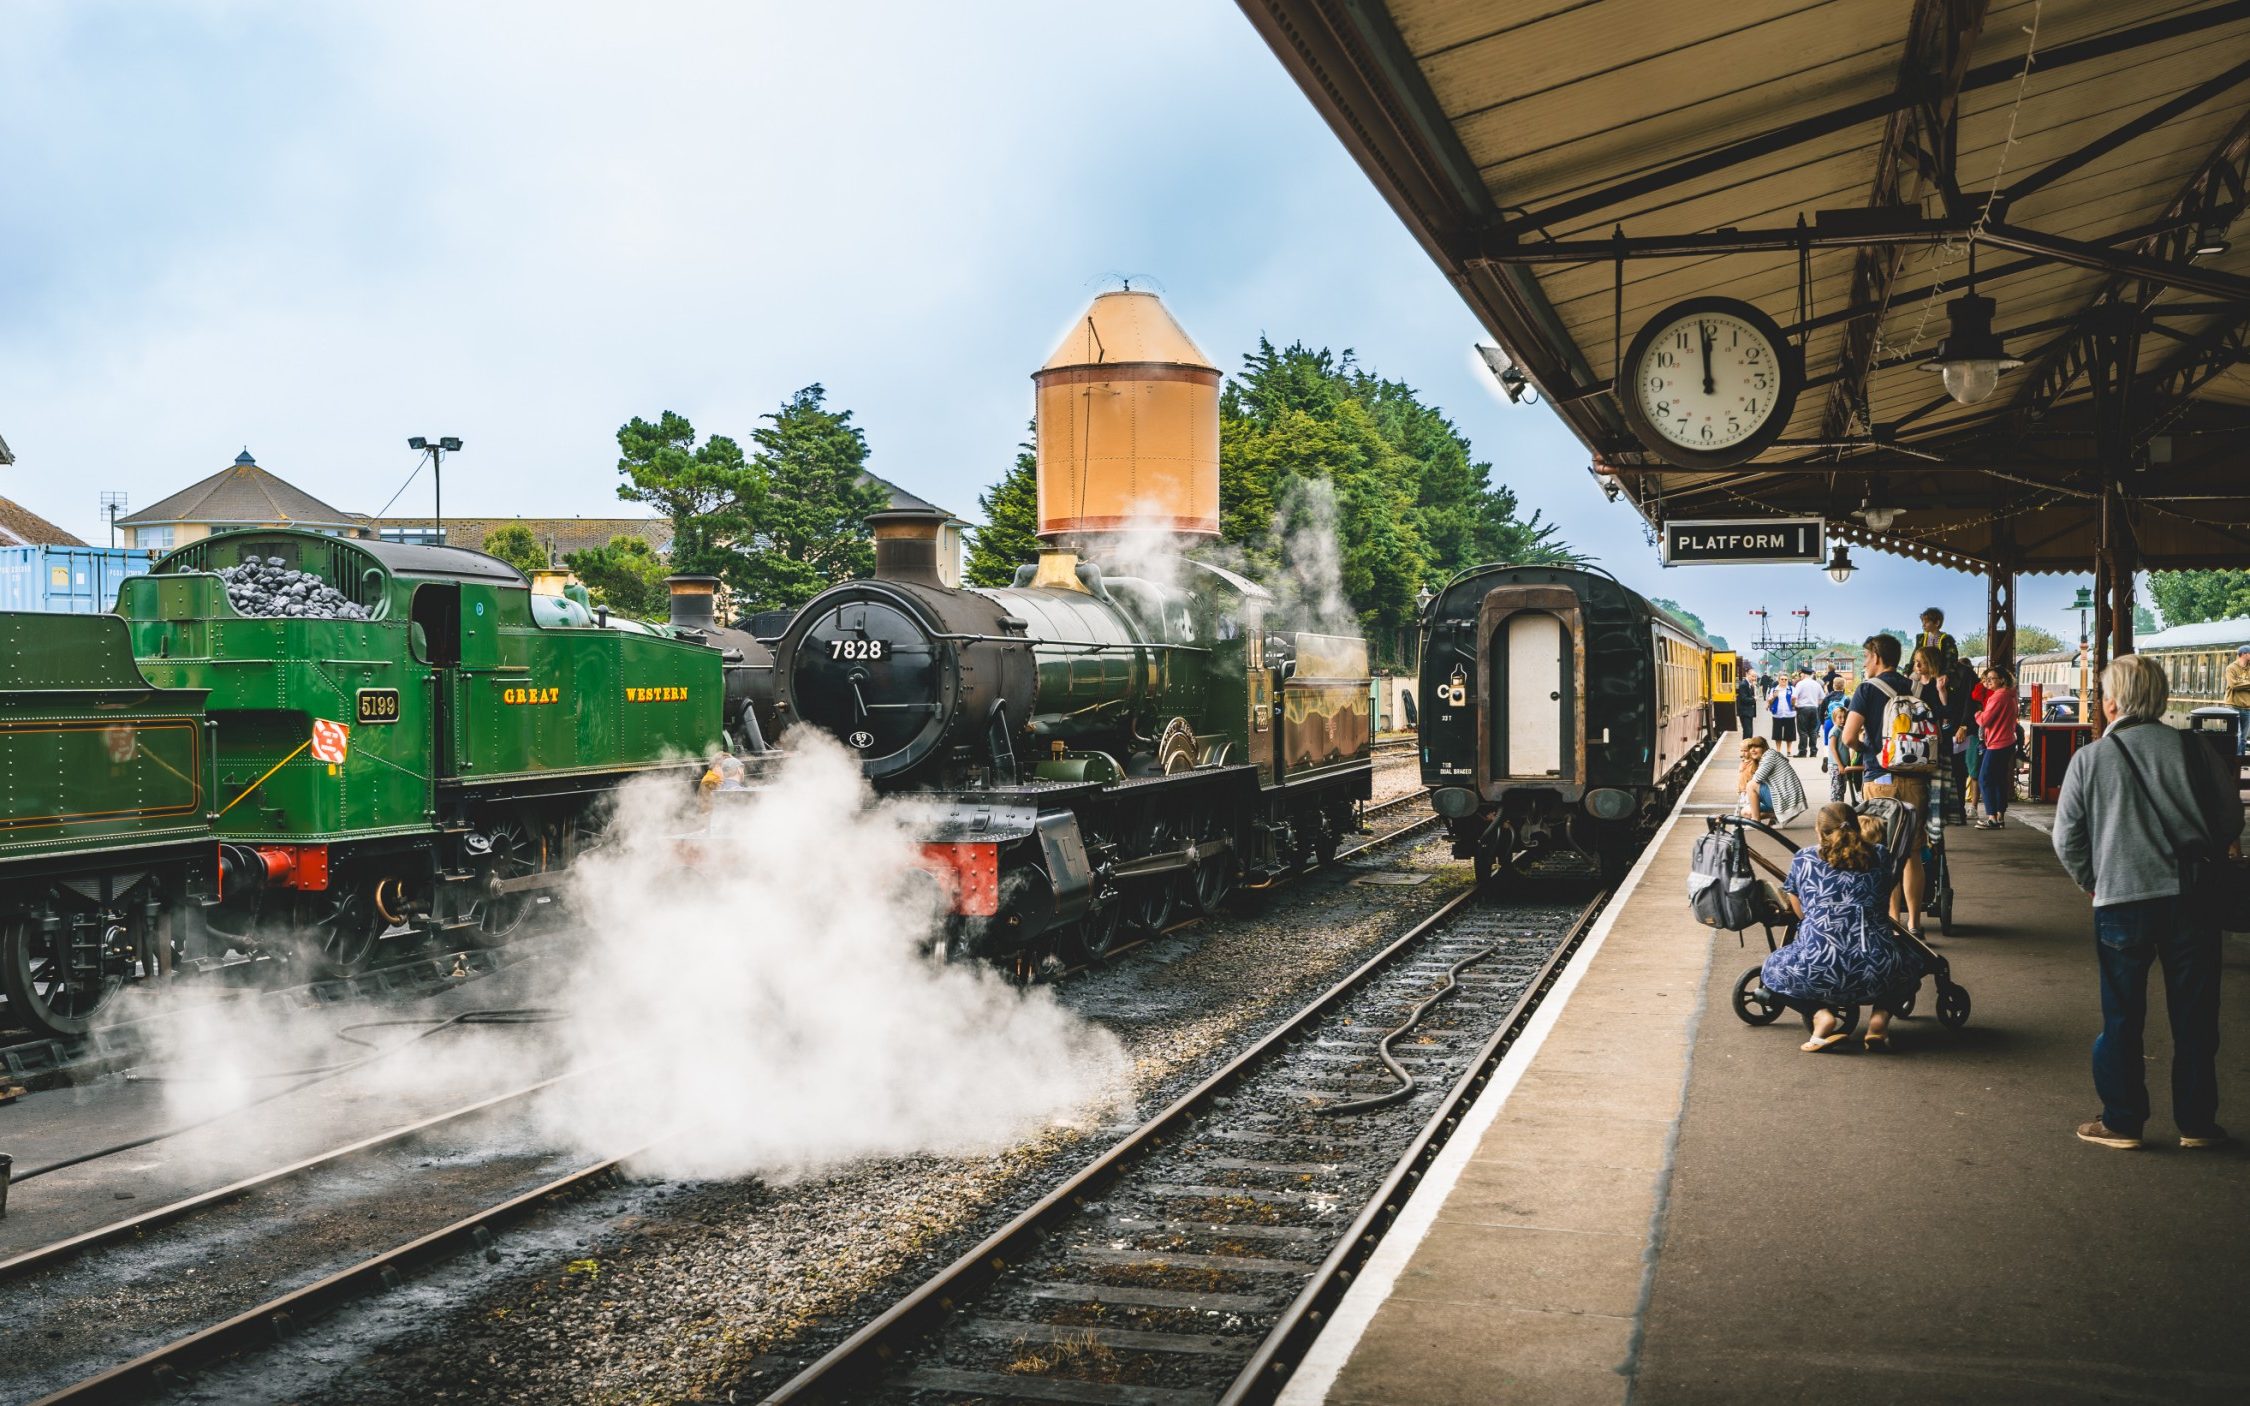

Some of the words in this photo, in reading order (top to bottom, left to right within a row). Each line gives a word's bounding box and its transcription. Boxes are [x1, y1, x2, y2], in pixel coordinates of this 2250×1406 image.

[1677, 332, 1688, 349] 11
[1733, 330, 1737, 347] 1
[1657, 352, 1673, 368] 10
[1745, 347, 1760, 365] 2
[1650, 376, 1664, 393] 9
[1753, 373, 1767, 390] 3
[1656, 400, 1670, 417] 8
[1744, 398, 1758, 415] 4
[1677, 418, 1688, 435] 7
[1701, 424, 1713, 441] 6
[1727, 416, 1740, 434] 5
[1679, 534, 1785, 550] PLATFORM
[1798, 527, 1805, 553] 1
[831, 640, 882, 659] 7828
[503, 687, 559, 705] GREAT
[625, 686, 688, 704] WESTERN
[361, 696, 395, 716] 5199
[856, 733, 867, 741] 89
